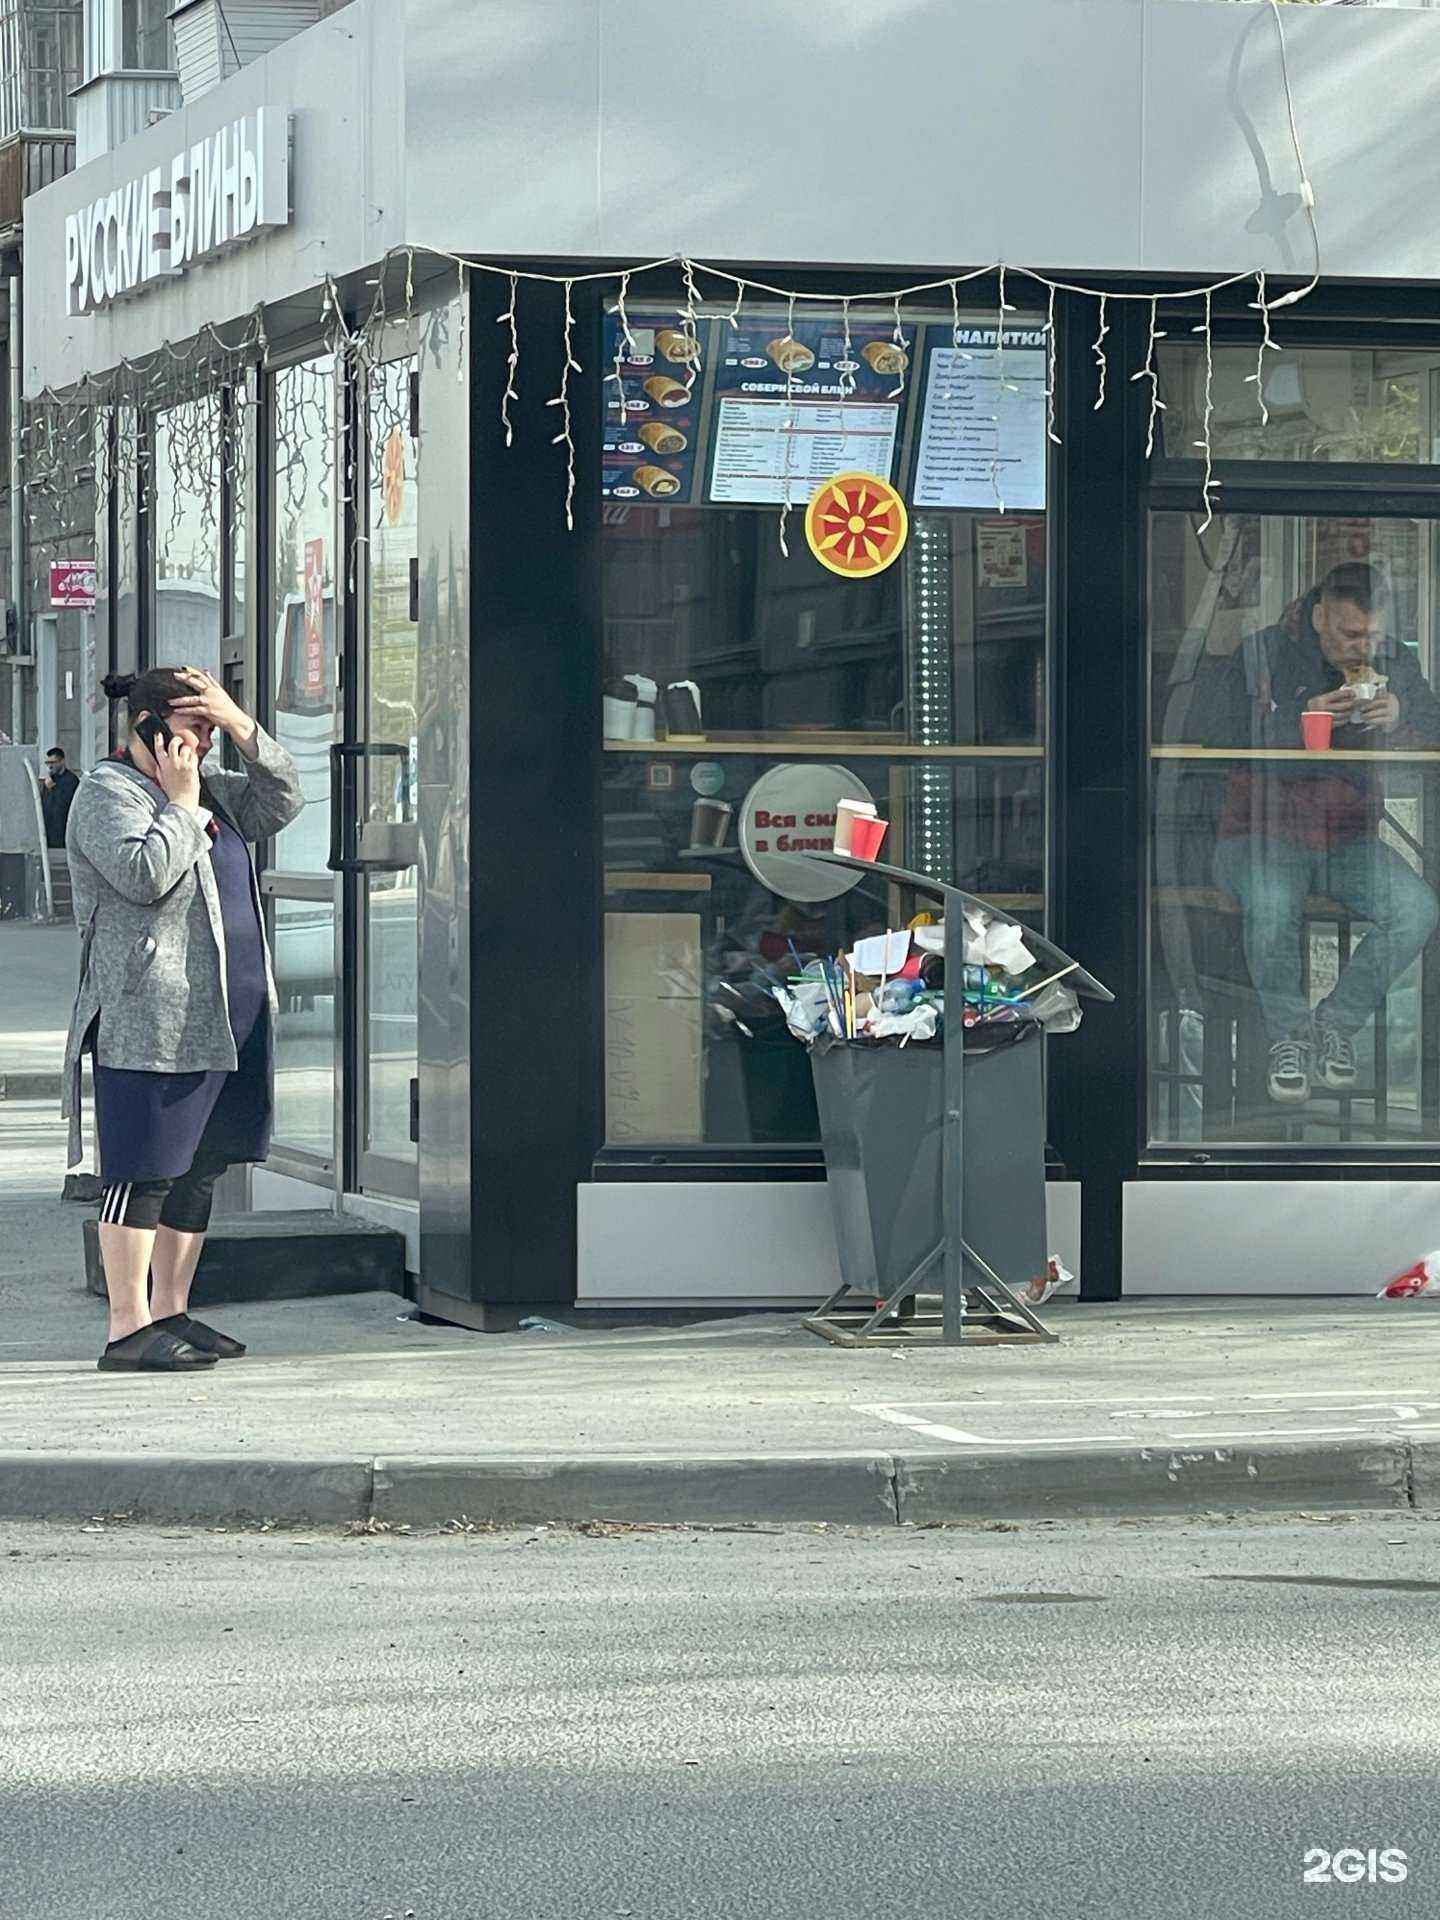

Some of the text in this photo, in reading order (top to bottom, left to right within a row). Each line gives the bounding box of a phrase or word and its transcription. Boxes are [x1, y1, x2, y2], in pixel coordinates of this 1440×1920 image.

[66, 106, 272, 317] РУССКИЕ БЛИНЫ
[956, 330, 1047, 346] НАПИТКИ
[788, 382, 820, 394] СВОЙ
[755, 811, 837, 828] Вся сил
[755, 834, 834, 852] в блин
